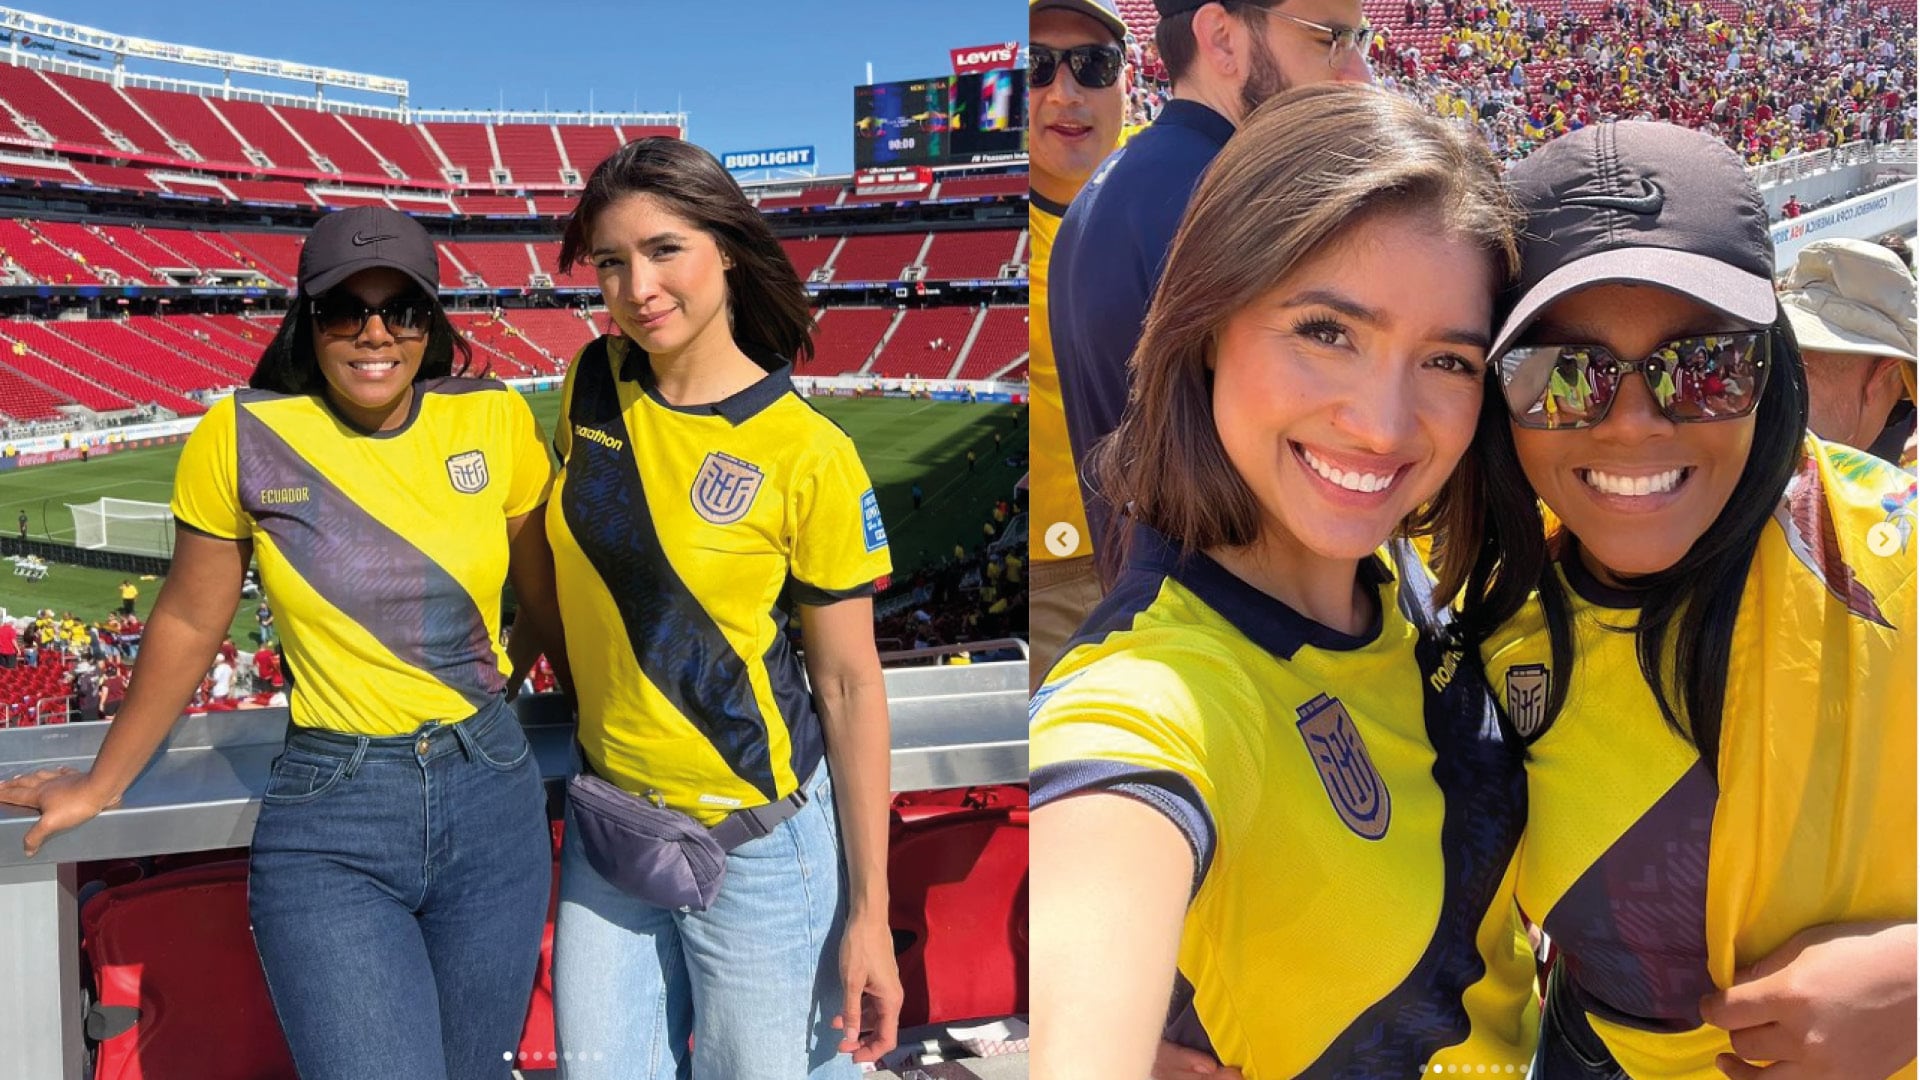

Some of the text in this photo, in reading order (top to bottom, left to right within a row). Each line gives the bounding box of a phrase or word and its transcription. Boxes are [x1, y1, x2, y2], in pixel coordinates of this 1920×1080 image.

[725, 149, 810, 169] BUD LIGHT
[260, 487, 310, 504] ECUADOR
